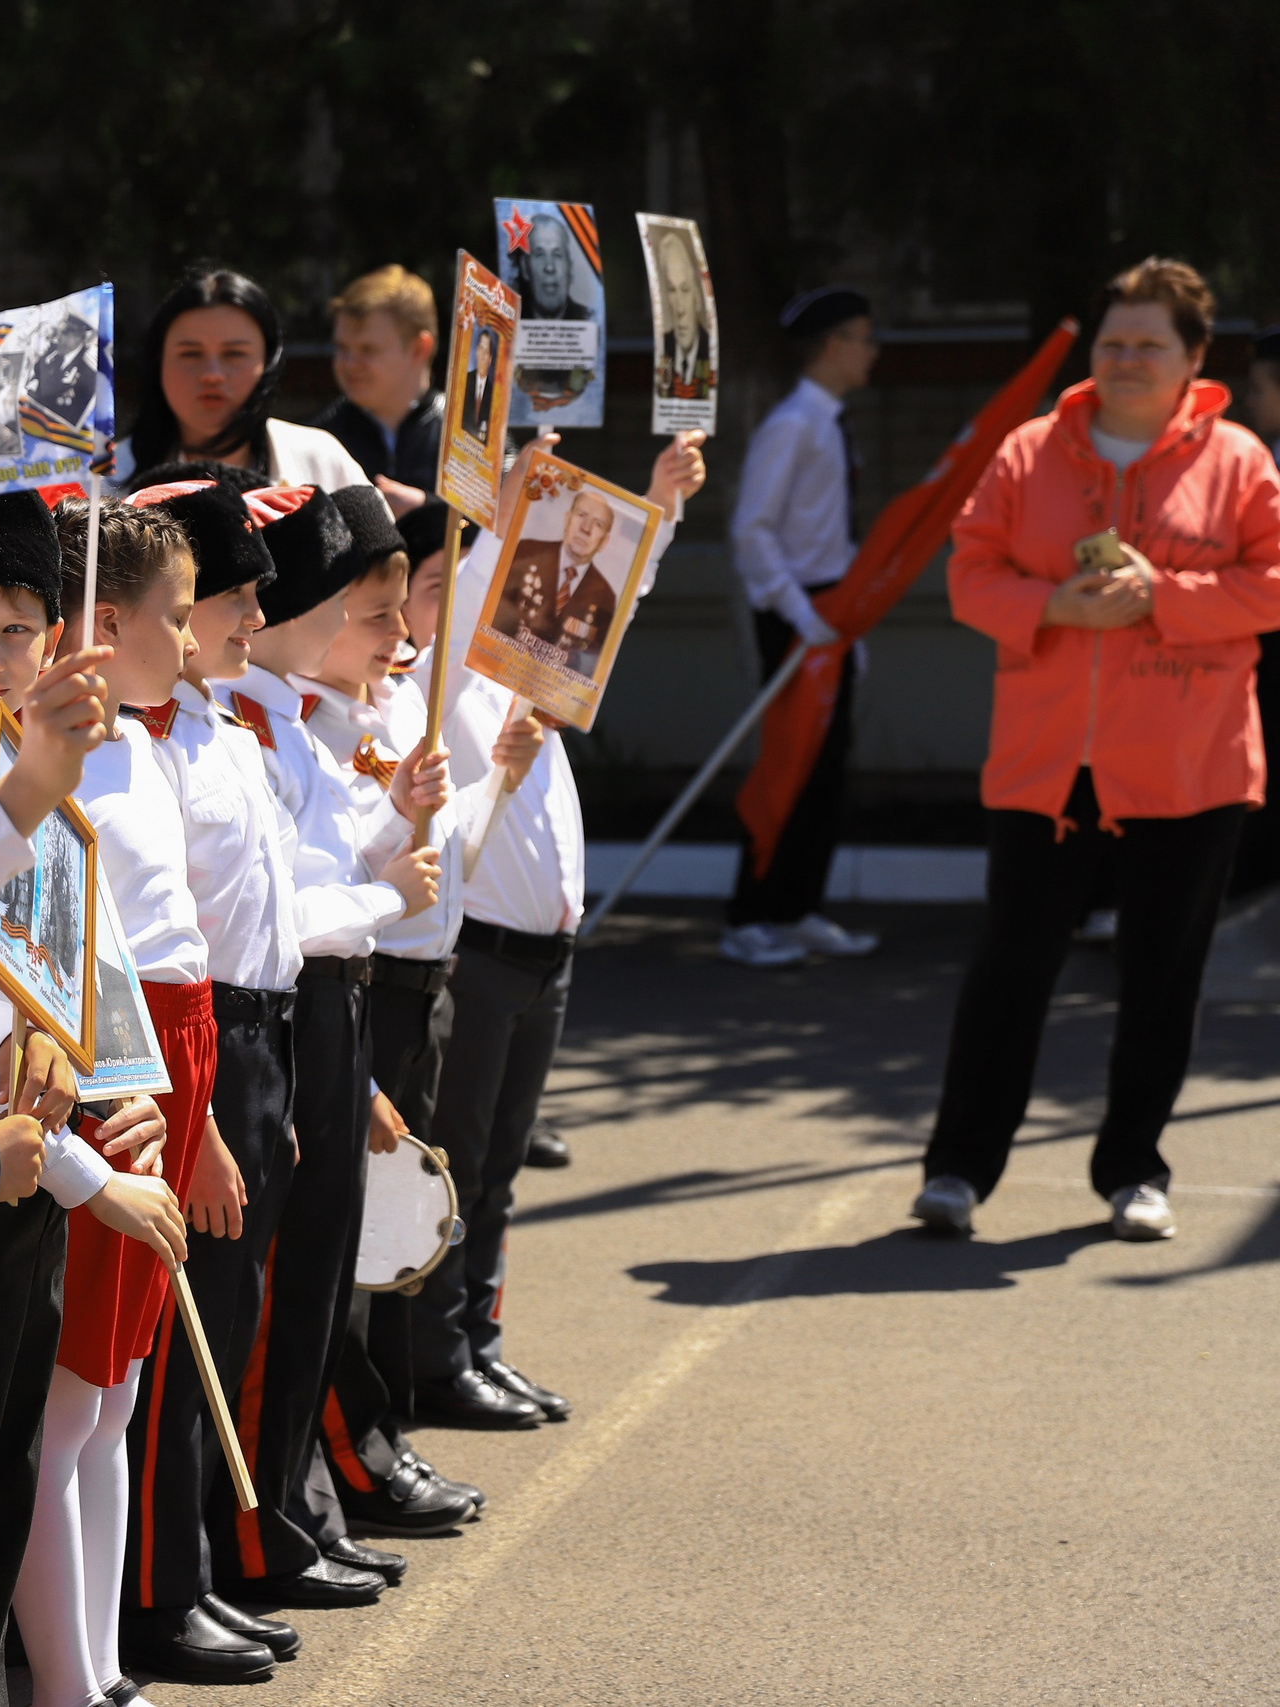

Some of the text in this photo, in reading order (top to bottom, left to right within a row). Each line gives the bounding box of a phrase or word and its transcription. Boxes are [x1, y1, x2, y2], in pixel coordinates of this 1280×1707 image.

[94, 1060, 106, 1069] ков
[106, 1056, 123, 1069] Юрий
[79, 1077, 98, 1087] Ветеран
